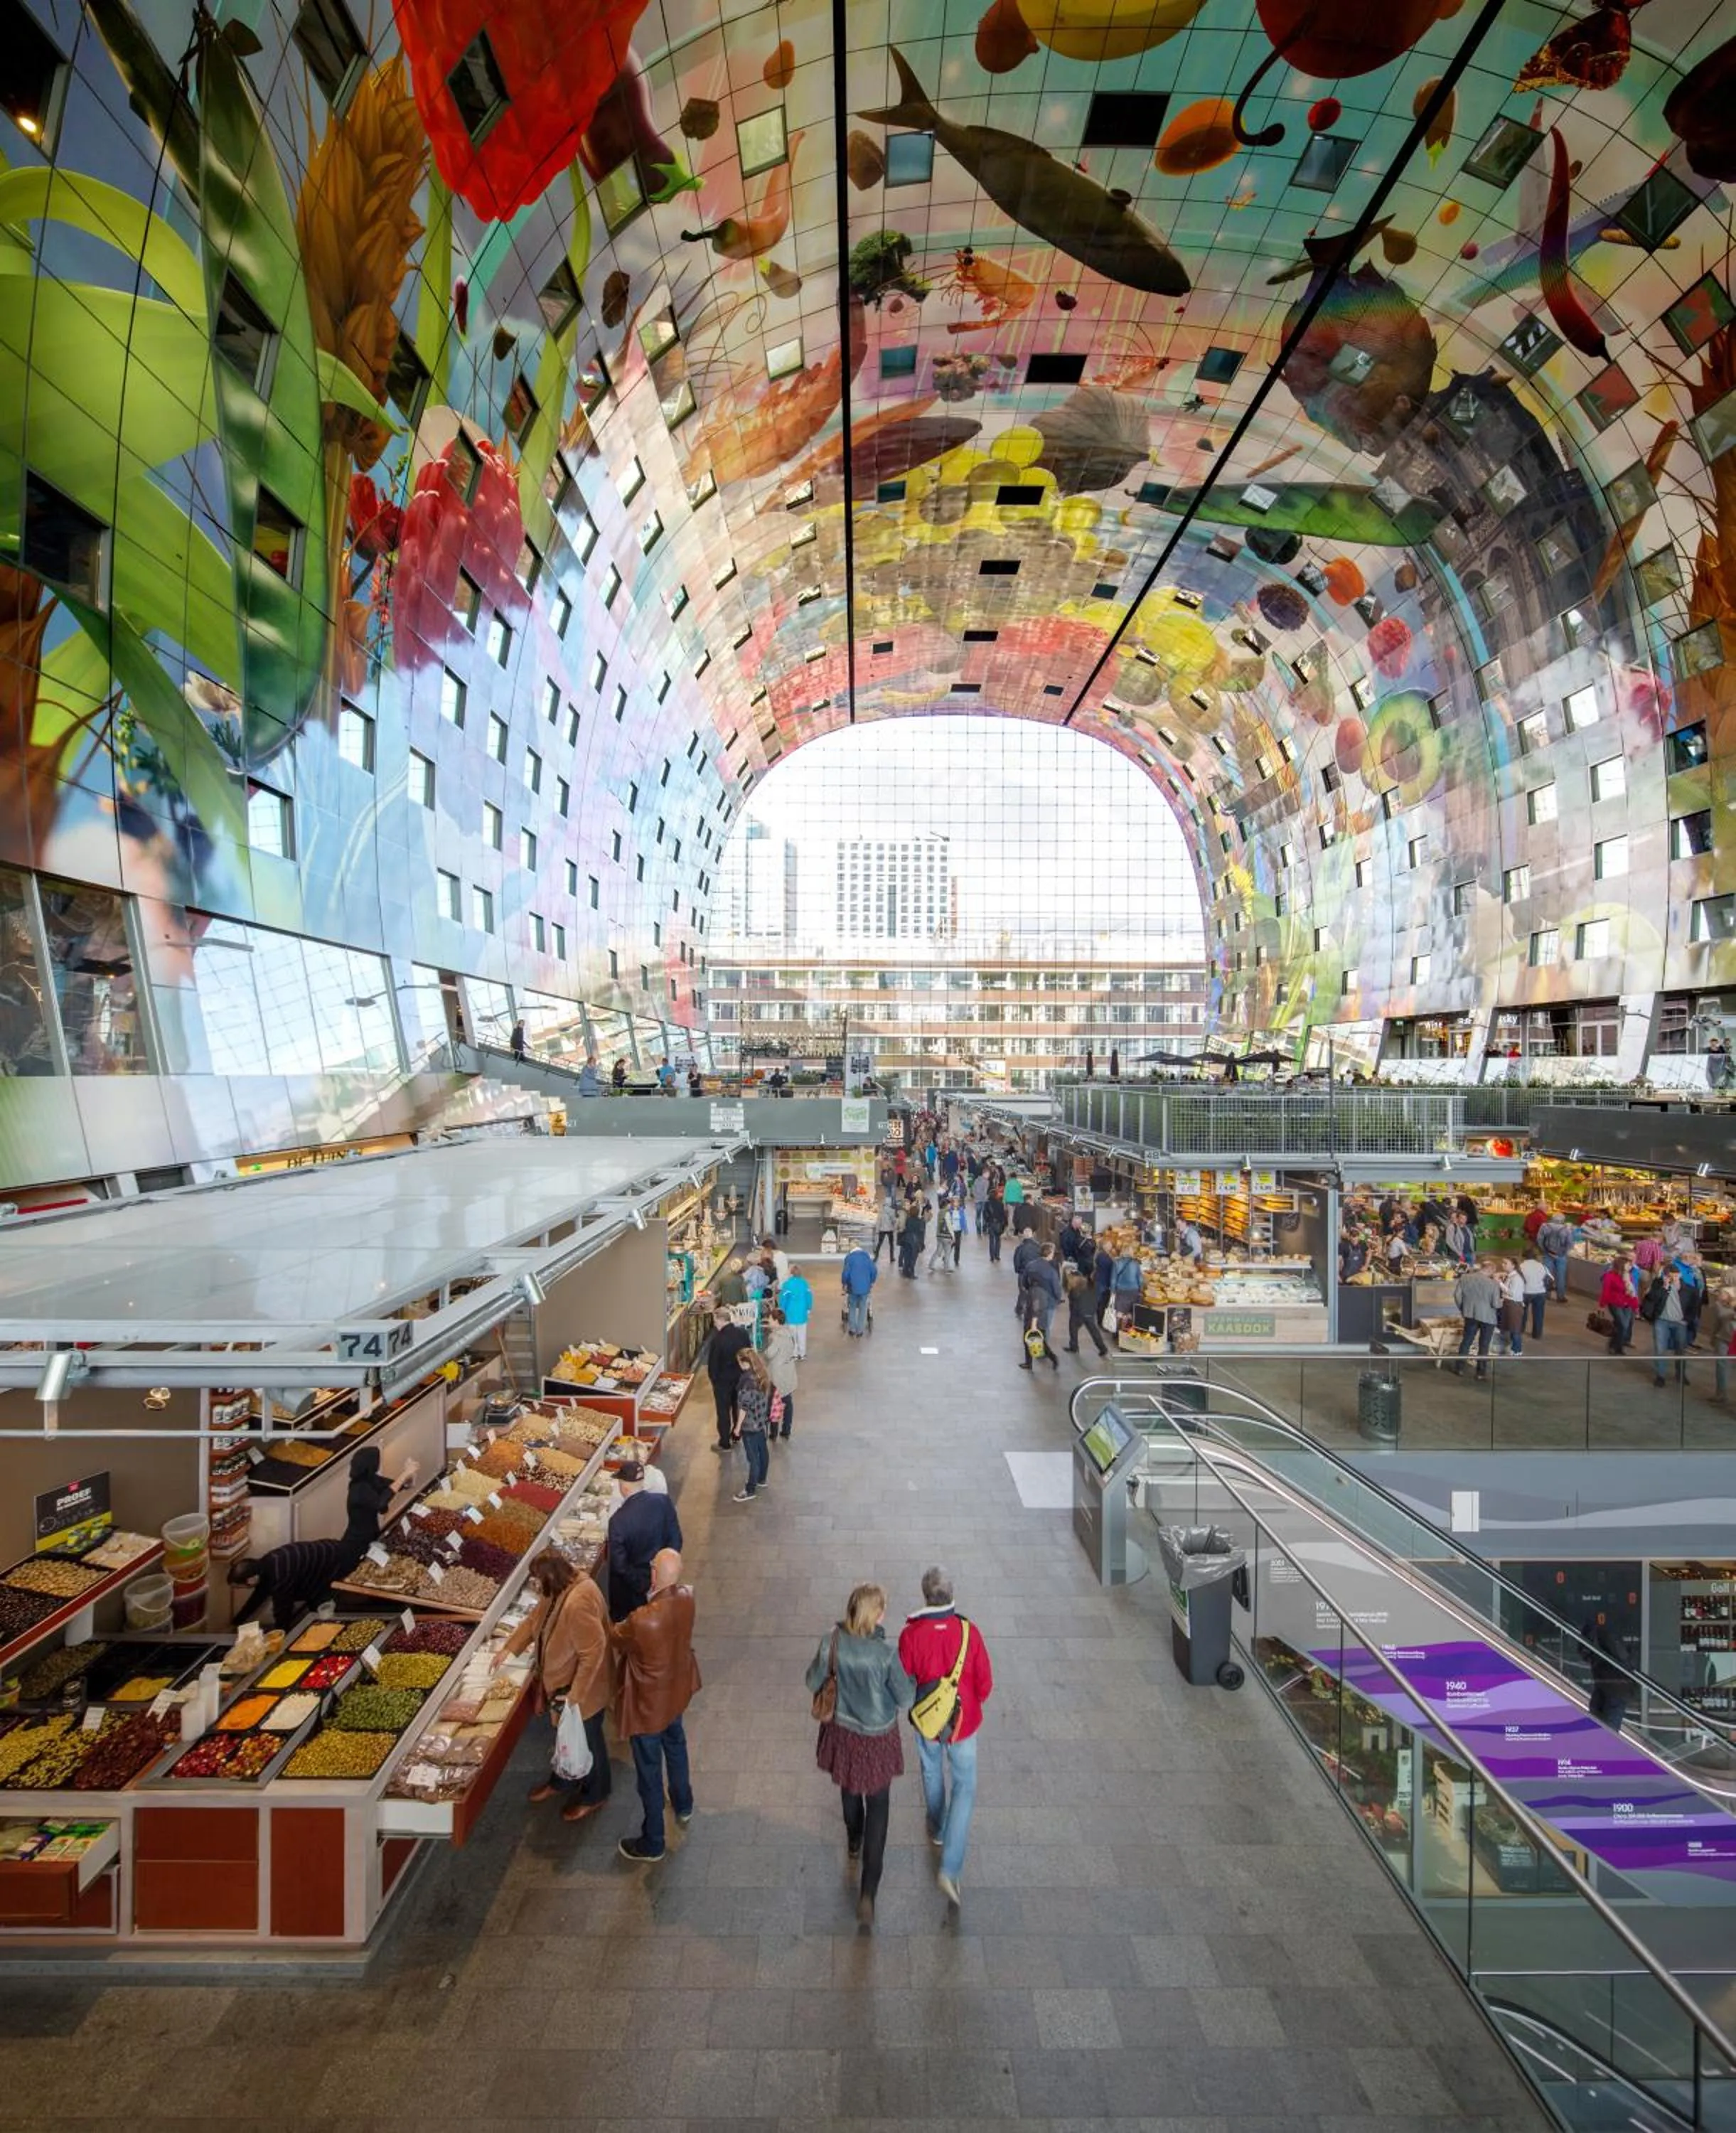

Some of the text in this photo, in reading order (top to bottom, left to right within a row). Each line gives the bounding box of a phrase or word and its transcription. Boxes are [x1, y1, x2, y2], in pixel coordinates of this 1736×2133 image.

[341, 1335, 382, 1357] 74
[389, 1323, 412, 1354] 74
[1445, 1682, 1467, 1690] 1940
[1612, 1802, 1634, 1812] 1900
